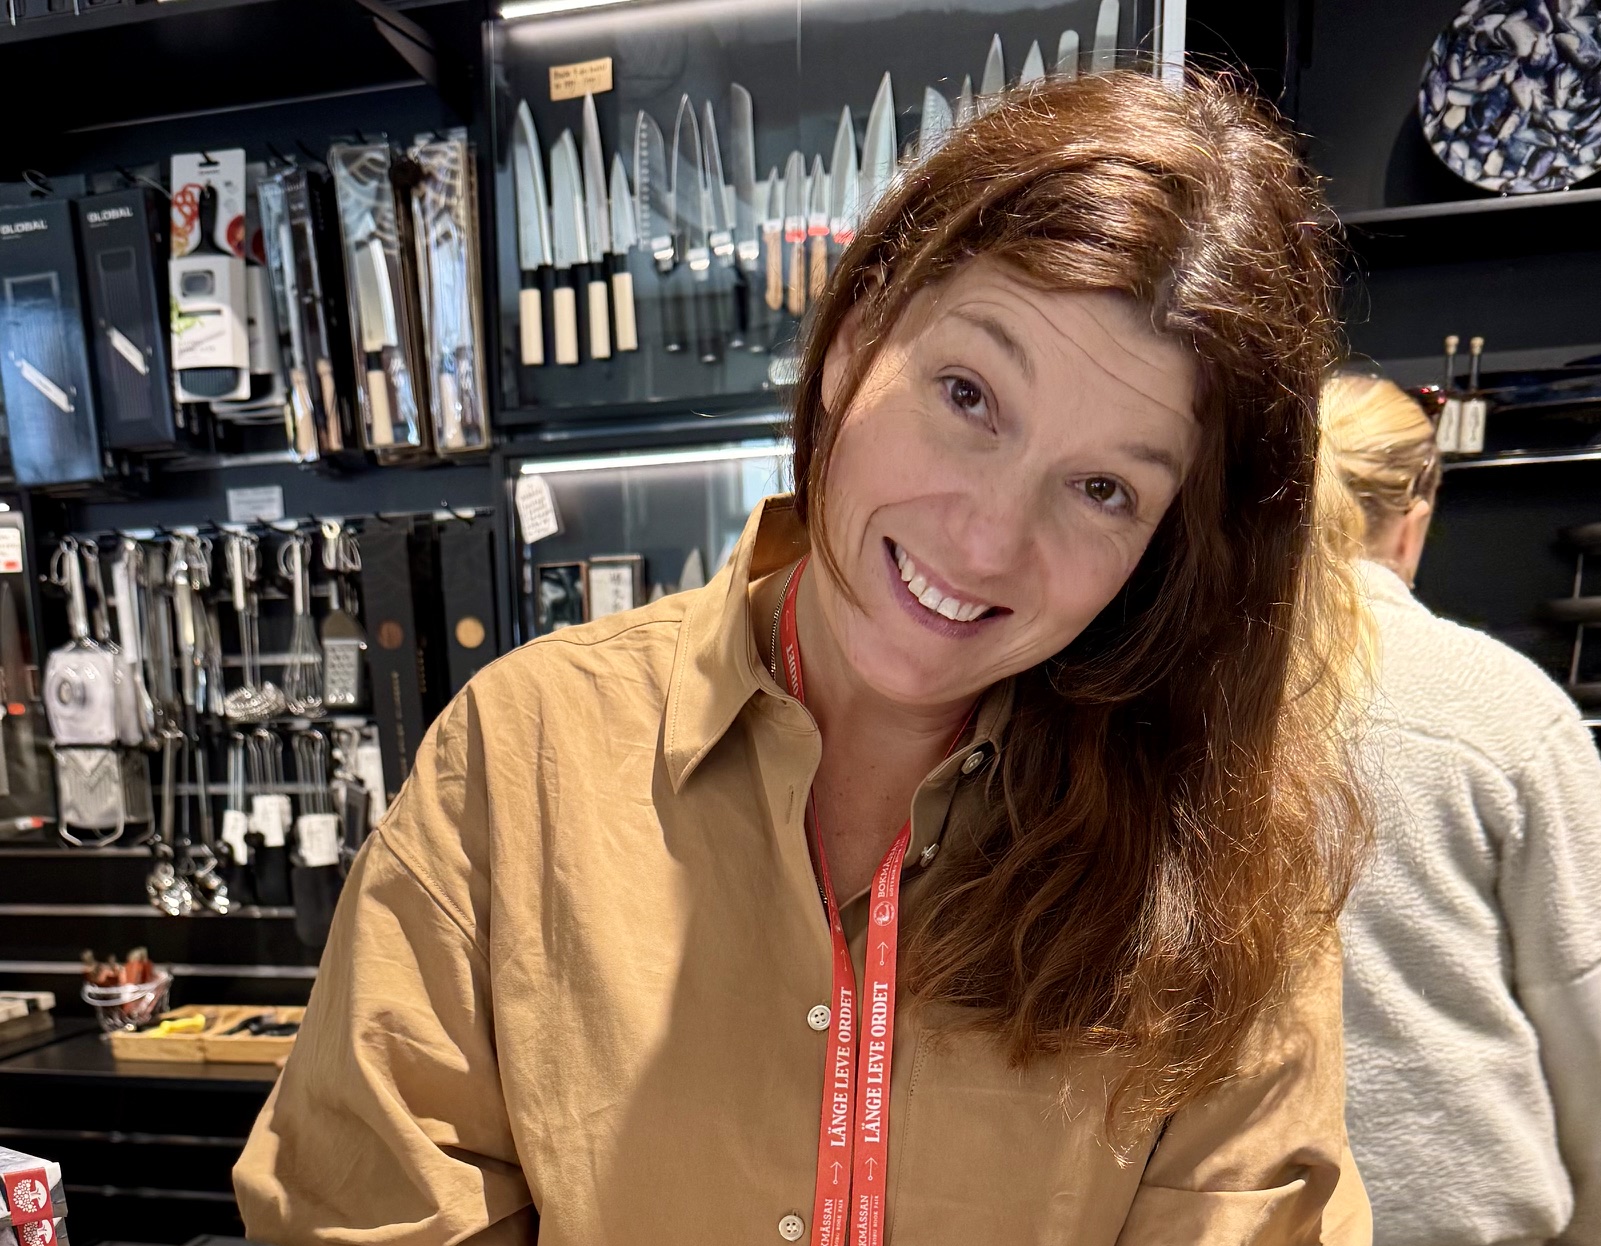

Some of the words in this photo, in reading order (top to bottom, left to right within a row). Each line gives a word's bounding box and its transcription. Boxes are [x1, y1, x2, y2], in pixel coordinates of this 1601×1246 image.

[0, 220, 48, 235] GLOBAL
[87, 207, 134, 223] GLOBAL
[838, 986, 852, 1043] ORDET
[871, 981, 889, 1038] ORDET
[835, 1046, 851, 1089] LEVE
[867, 1041, 885, 1084] LEVE
[828, 1092, 847, 1147] LÄNGE
[861, 1087, 882, 1143] LÄNGE
